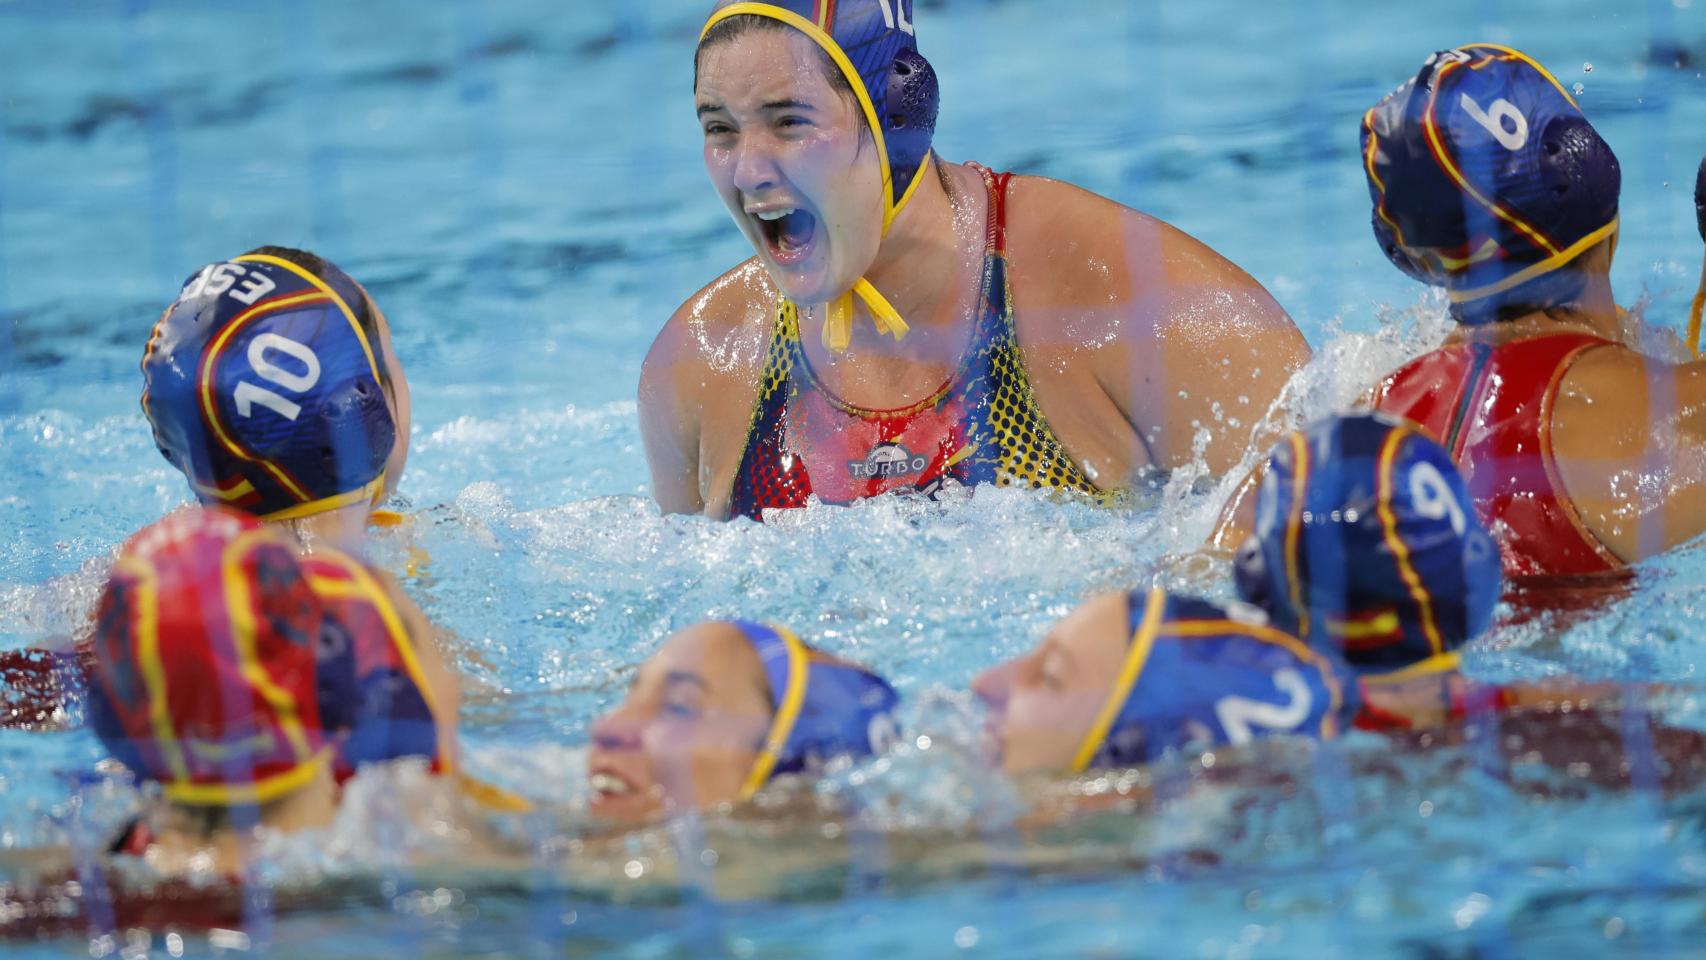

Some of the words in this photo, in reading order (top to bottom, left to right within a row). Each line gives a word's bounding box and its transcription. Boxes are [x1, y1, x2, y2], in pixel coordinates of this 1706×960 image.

[1461, 92, 1529, 151] 6
[233, 332, 321, 421] 10
[851, 457, 926, 477] TURBO
[1409, 461, 1466, 538] 9
[1214, 667, 1313, 748] 2
